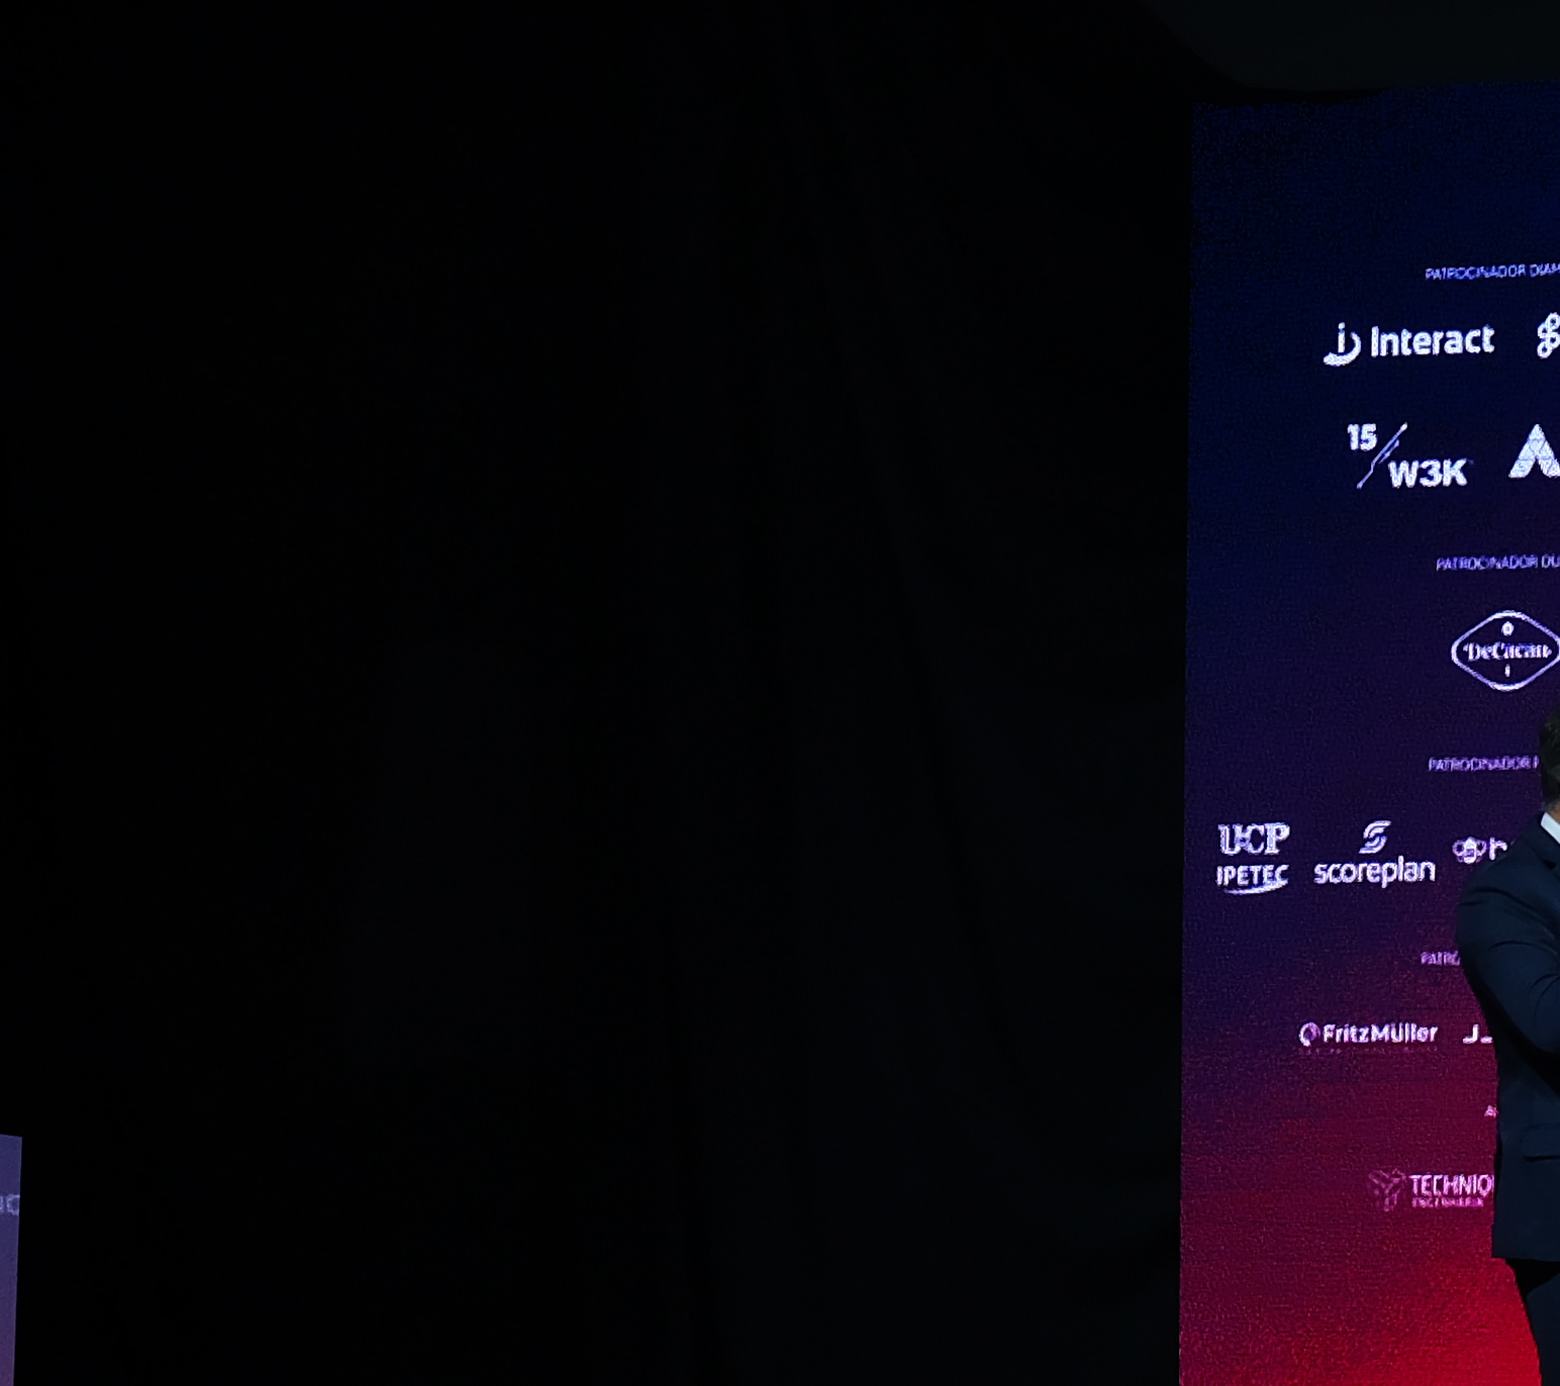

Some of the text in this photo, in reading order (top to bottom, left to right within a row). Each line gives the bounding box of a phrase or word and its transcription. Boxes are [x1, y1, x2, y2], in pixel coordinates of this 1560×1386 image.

[1371, 326, 1494, 357] Interact
[1347, 424, 1377, 451] 15
[1388, 458, 1467, 487] W3K
[1218, 823, 1290, 855] UCP
[1216, 865, 1289, 885] IPETEC
[1314, 856, 1436, 888] scoreplan
